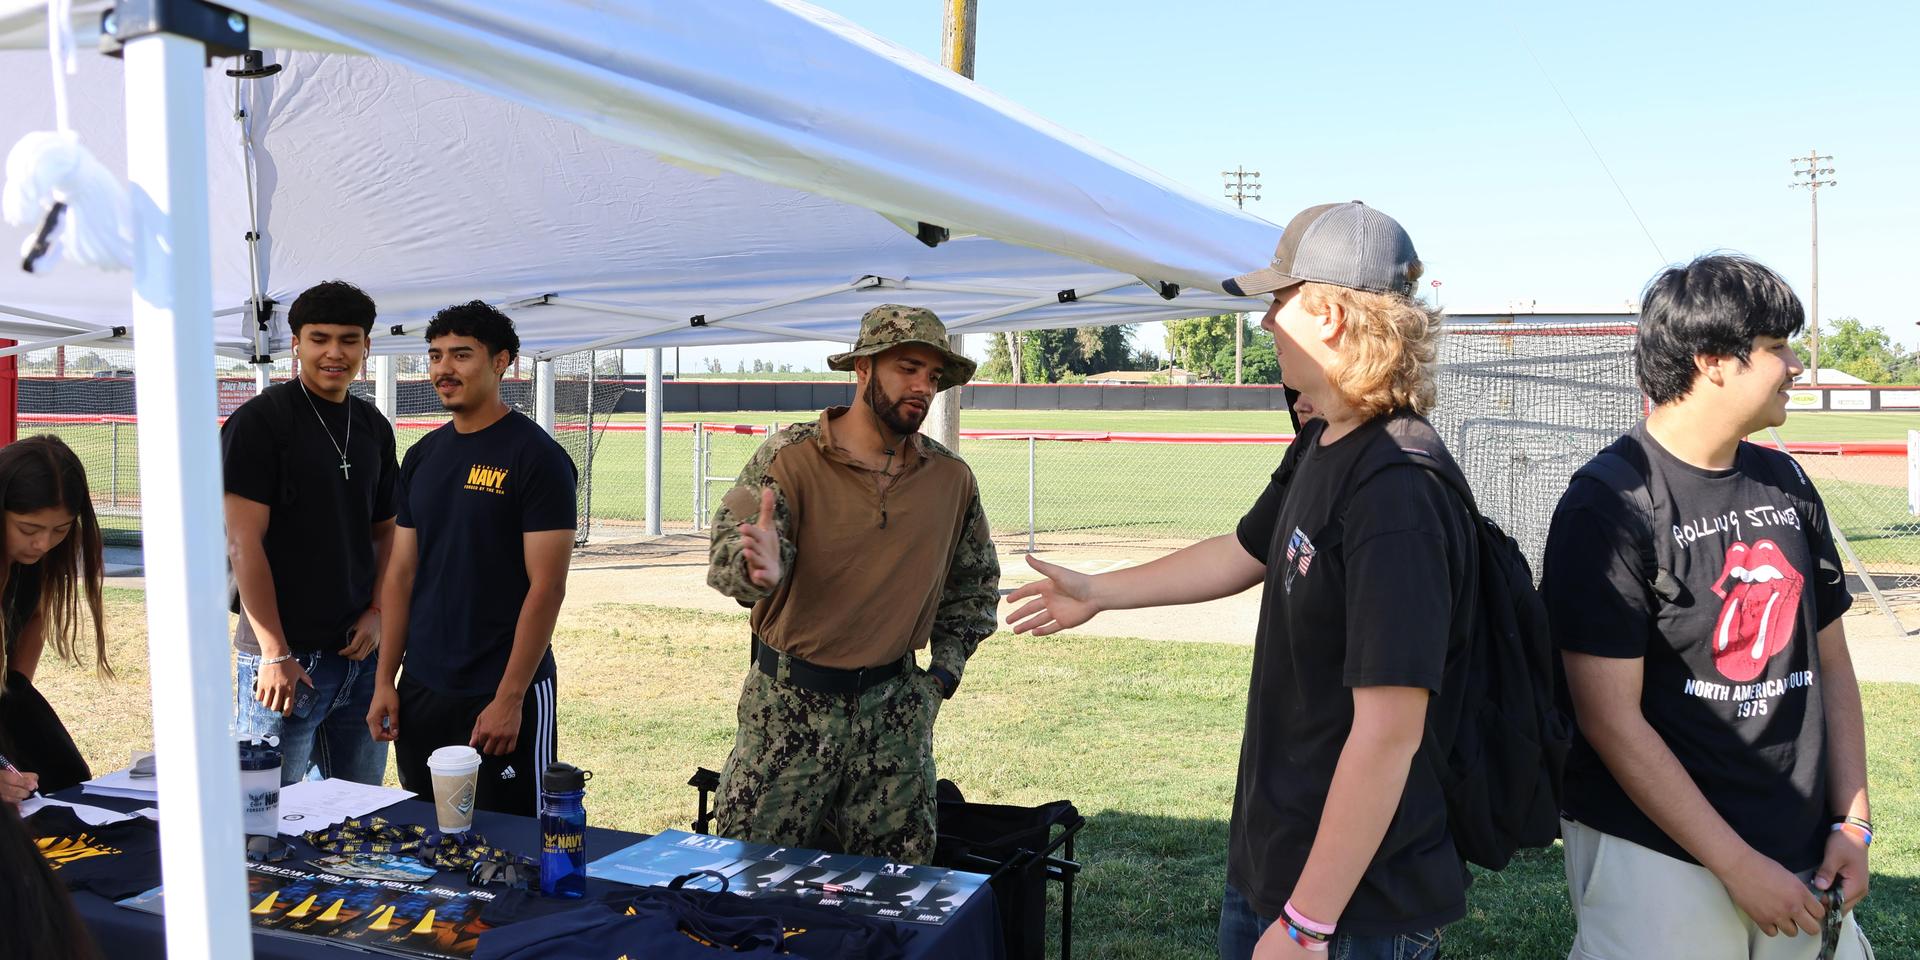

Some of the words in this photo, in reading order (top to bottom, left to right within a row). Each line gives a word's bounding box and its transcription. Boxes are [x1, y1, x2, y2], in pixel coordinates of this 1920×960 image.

[467, 467, 507, 489] NAVY
[1672, 510, 1741, 549] ROLLING
[1684, 679, 1730, 701] NORTH
[1787, 670, 1813, 689] OUR
[1737, 699, 1768, 718] 1975
[557, 834, 583, 849] NAVY
[880, 862, 914, 874] AT
